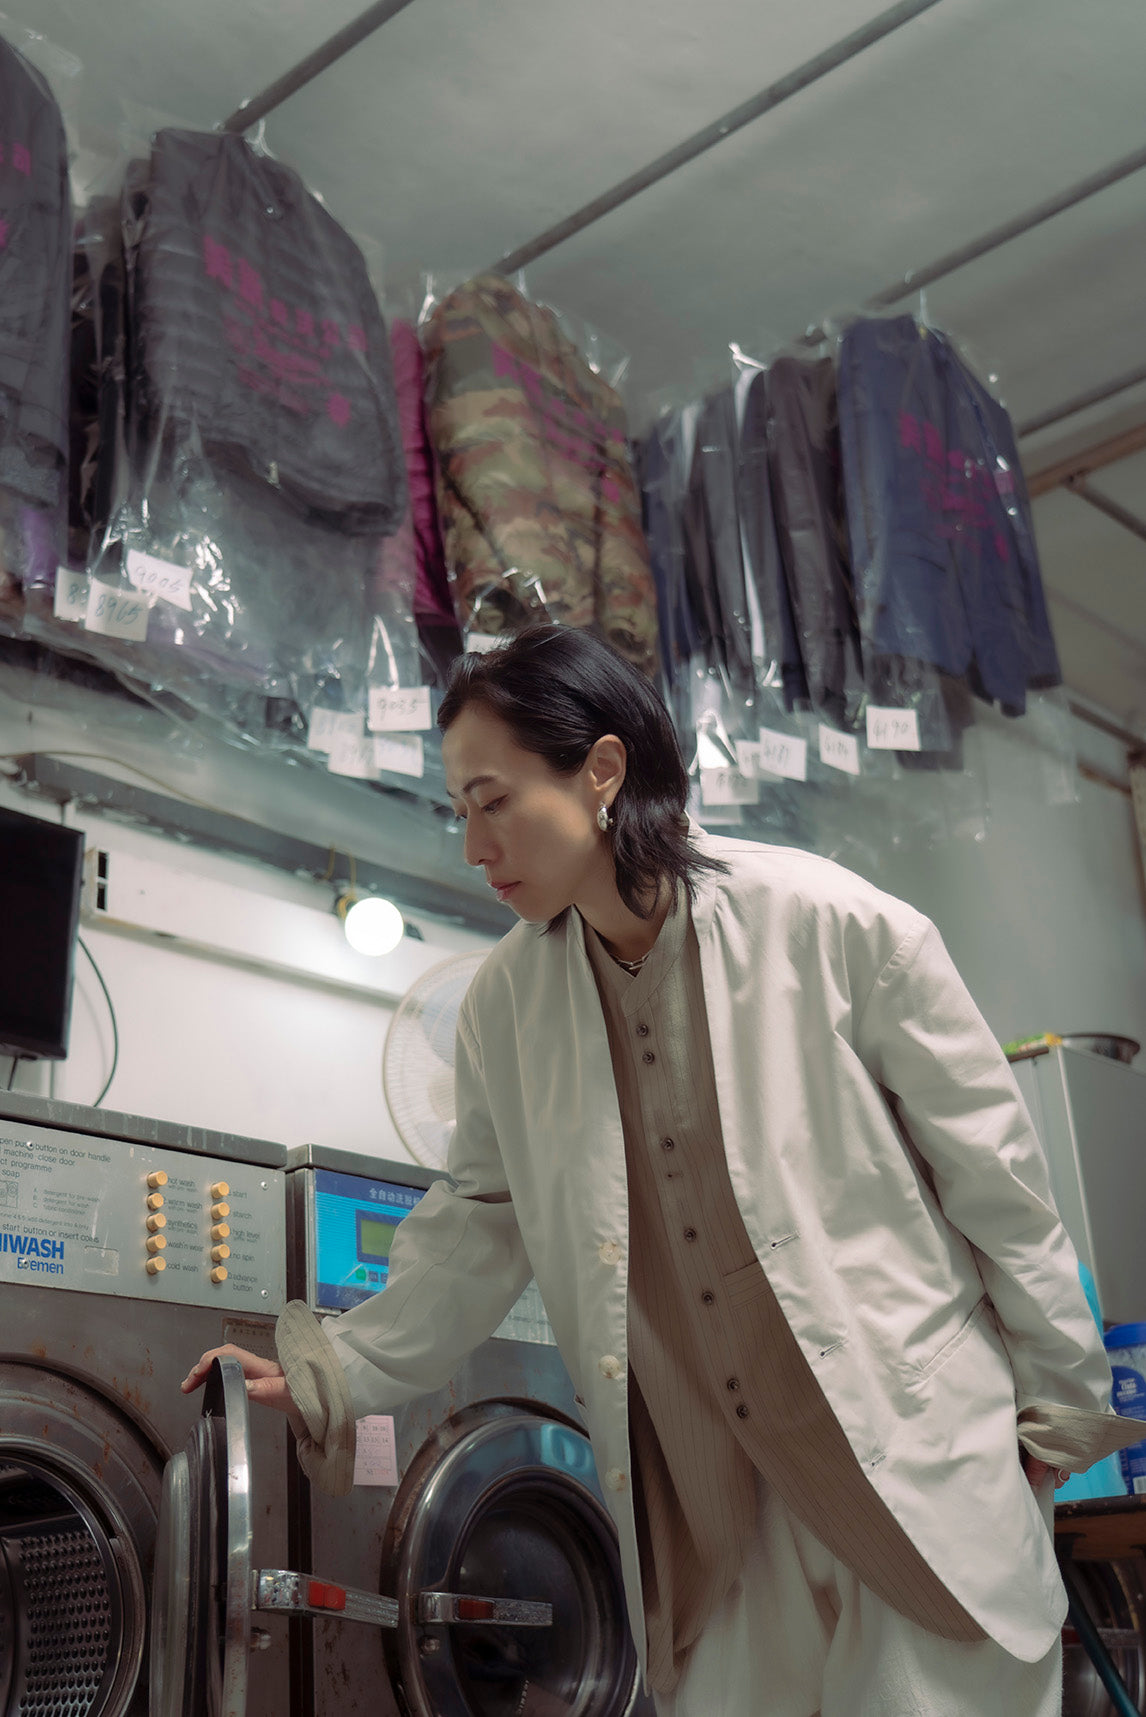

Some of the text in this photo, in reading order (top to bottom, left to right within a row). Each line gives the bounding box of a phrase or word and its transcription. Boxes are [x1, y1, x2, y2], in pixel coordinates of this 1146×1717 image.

[4, 1148, 33, 1160] machine
[59, 1157, 75, 1166] door
[35, 1143, 57, 1153] button
[59, 1147, 69, 1155] on
[70, 1148, 86, 1158] door
[88, 1152, 112, 1163] handle
[11, 1160, 53, 1174] programme
[2, 1169, 20, 1179] soap
[179, 1180, 196, 1188] wash
[186, 1202, 203, 1210] wash
[232, 1211, 253, 1220] starch
[167, 1219, 198, 1230] synthetics
[2, 1223, 20, 1232] start
[23, 1226, 48, 1236] button
[58, 1231, 79, 1240] insert
[0, 1232, 64, 1260] IWASH
[17, 1257, 64, 1275] Bemen
[182, 1264, 199, 1273] wash
[232, 1281, 253, 1291] button
